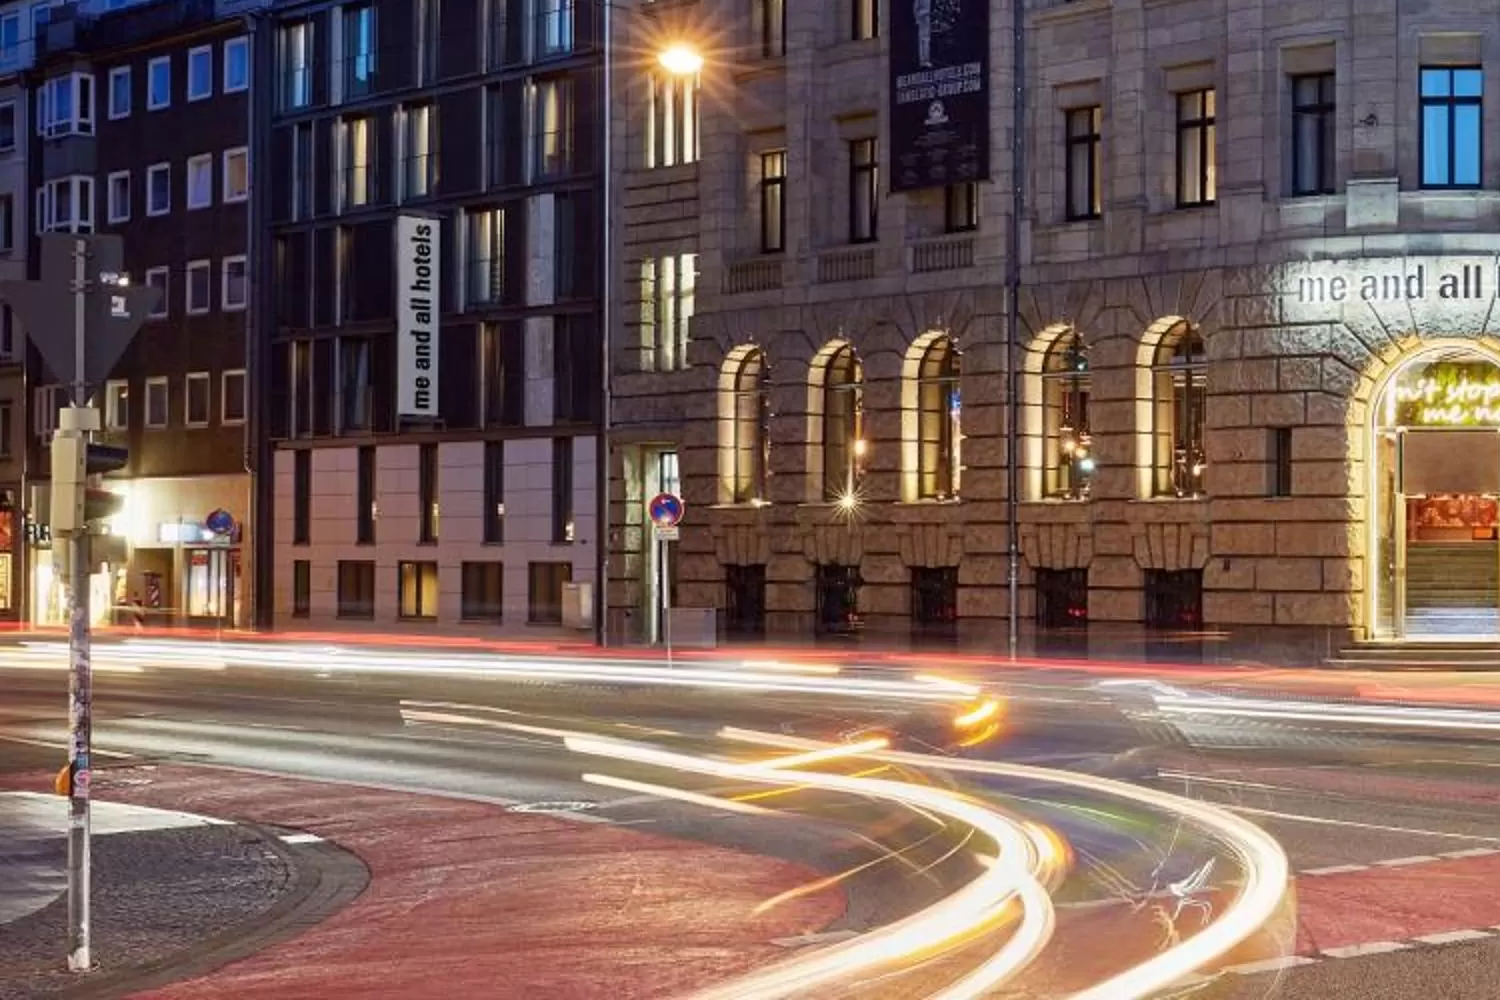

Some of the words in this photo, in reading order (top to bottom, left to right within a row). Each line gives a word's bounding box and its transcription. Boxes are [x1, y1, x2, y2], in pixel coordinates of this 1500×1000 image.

[410, 225, 431, 292] hotels
[1299, 273, 1347, 301] me
[1360, 264, 1424, 301] and
[1439, 264, 1482, 299] all
[410, 299, 430, 324] all
[410, 331, 430, 370] and
[415, 376, 430, 409] me
[1423, 405, 1468, 423] me
